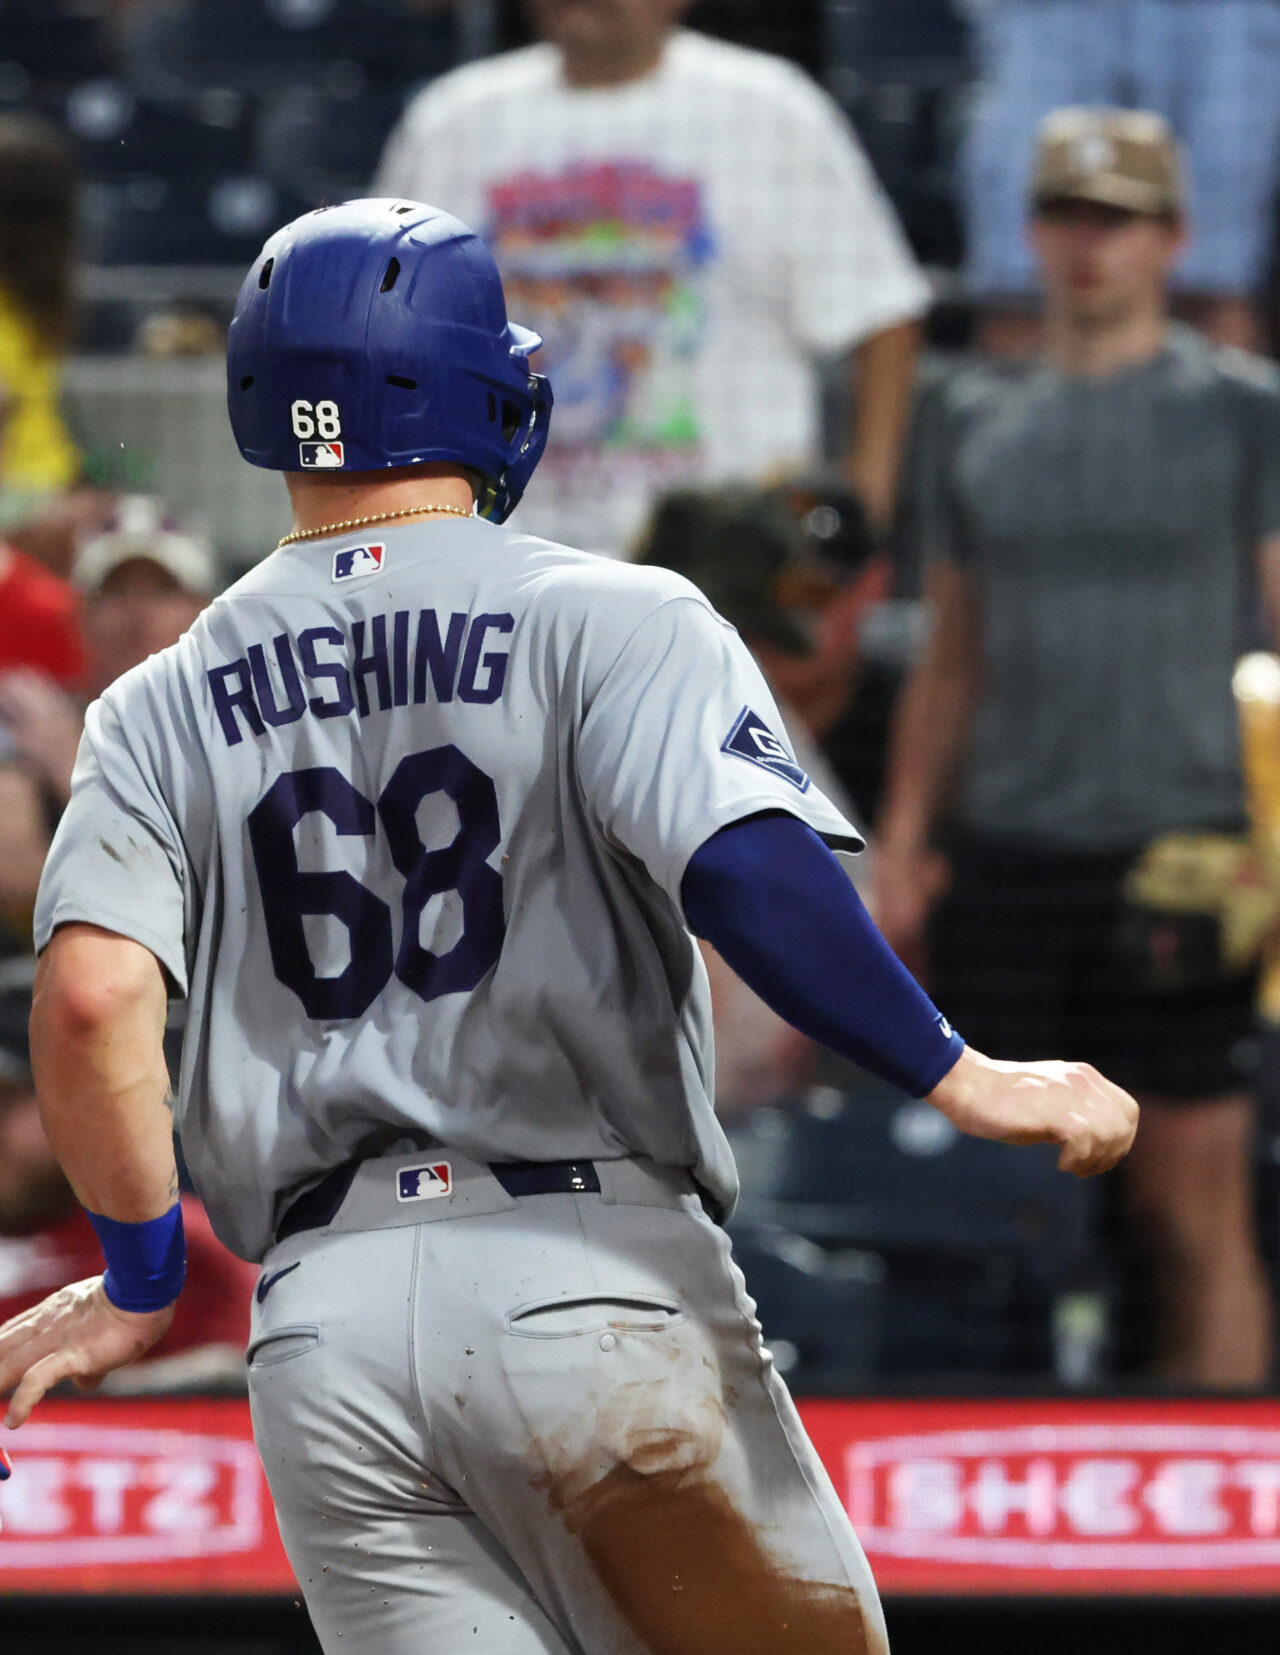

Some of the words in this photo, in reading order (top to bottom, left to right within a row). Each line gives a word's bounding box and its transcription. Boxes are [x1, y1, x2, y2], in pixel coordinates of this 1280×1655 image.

[291, 399, 342, 440] 68
[206, 608, 515, 747] RUSHING
[247, 743, 506, 1020] 68
